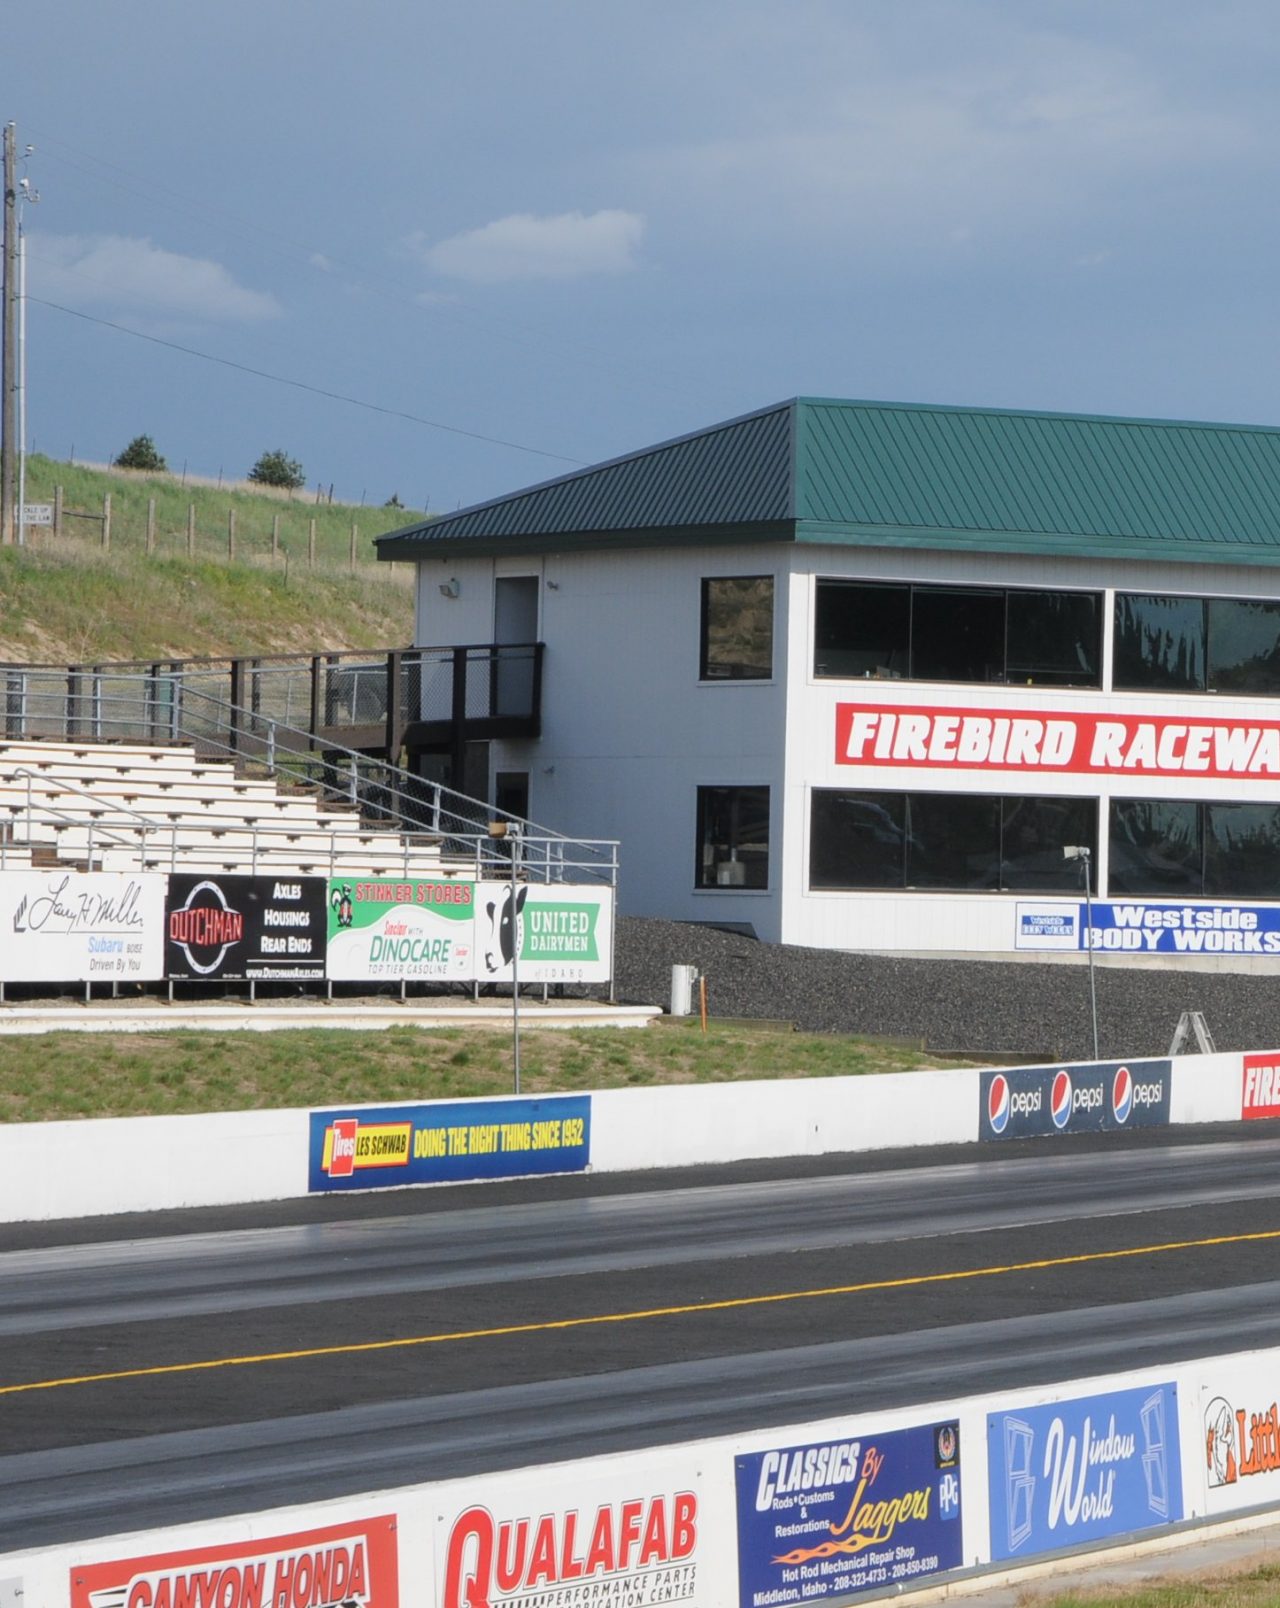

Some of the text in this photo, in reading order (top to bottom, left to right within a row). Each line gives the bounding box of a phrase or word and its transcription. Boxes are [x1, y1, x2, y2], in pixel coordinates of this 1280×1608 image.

[846, 712, 1077, 766] FIREBIRD
[273, 882, 302, 900] AXLES
[355, 882, 472, 905] STINKER STORES
[169, 907, 243, 946] DUTCHMAN
[264, 909, 310, 928] HOUSINGS
[530, 911, 589, 935] UNITED
[1112, 905, 1258, 930] Westside
[88, 935, 123, 953] Subaru
[261, 936, 312, 954] REAR ENDS
[369, 935, 452, 963] DINOCARE
[530, 935, 588, 952] DAIRYMEN
[1084, 927, 1164, 950] BODY
[90, 957, 141, 973] Driven By You
[388, 964, 405, 975] TIER
[406, 964, 448, 975] GASOLINE
[1010, 1086, 1042, 1114] pepsi
[1072, 1083, 1103, 1111] pepsi
[1132, 1079, 1163, 1107] pepsi
[332, 1128, 355, 1162] Tires
[356, 1133, 407, 1157] LES SCHWAB
[413, 1118, 584, 1158] DOING THE RIGHT THING SINCE 1952
[755, 1442, 884, 1512] CLASSICS By
[1043, 1413, 1135, 1530] Window
[772, 1490, 836, 1511] Rods Customs
[800, 1507, 808, 1519] &
[829, 1478, 932, 1540] Jaggers
[775, 1518, 831, 1538] Restorations
[443, 1490, 698, 1608] QUALAFAB
[126, 1542, 367, 1608] CANYON HONDA
[782, 1545, 916, 1583] Hot Rod Mechanical Repair Shop
[547, 1574, 649, 1608] PERFORMANCE
[655, 1566, 697, 1587] PARTS
[650, 1581, 695, 1602] CENTER
[753, 1586, 801, 1607] Middleton,
[802, 1580, 827, 1596] Idaho
